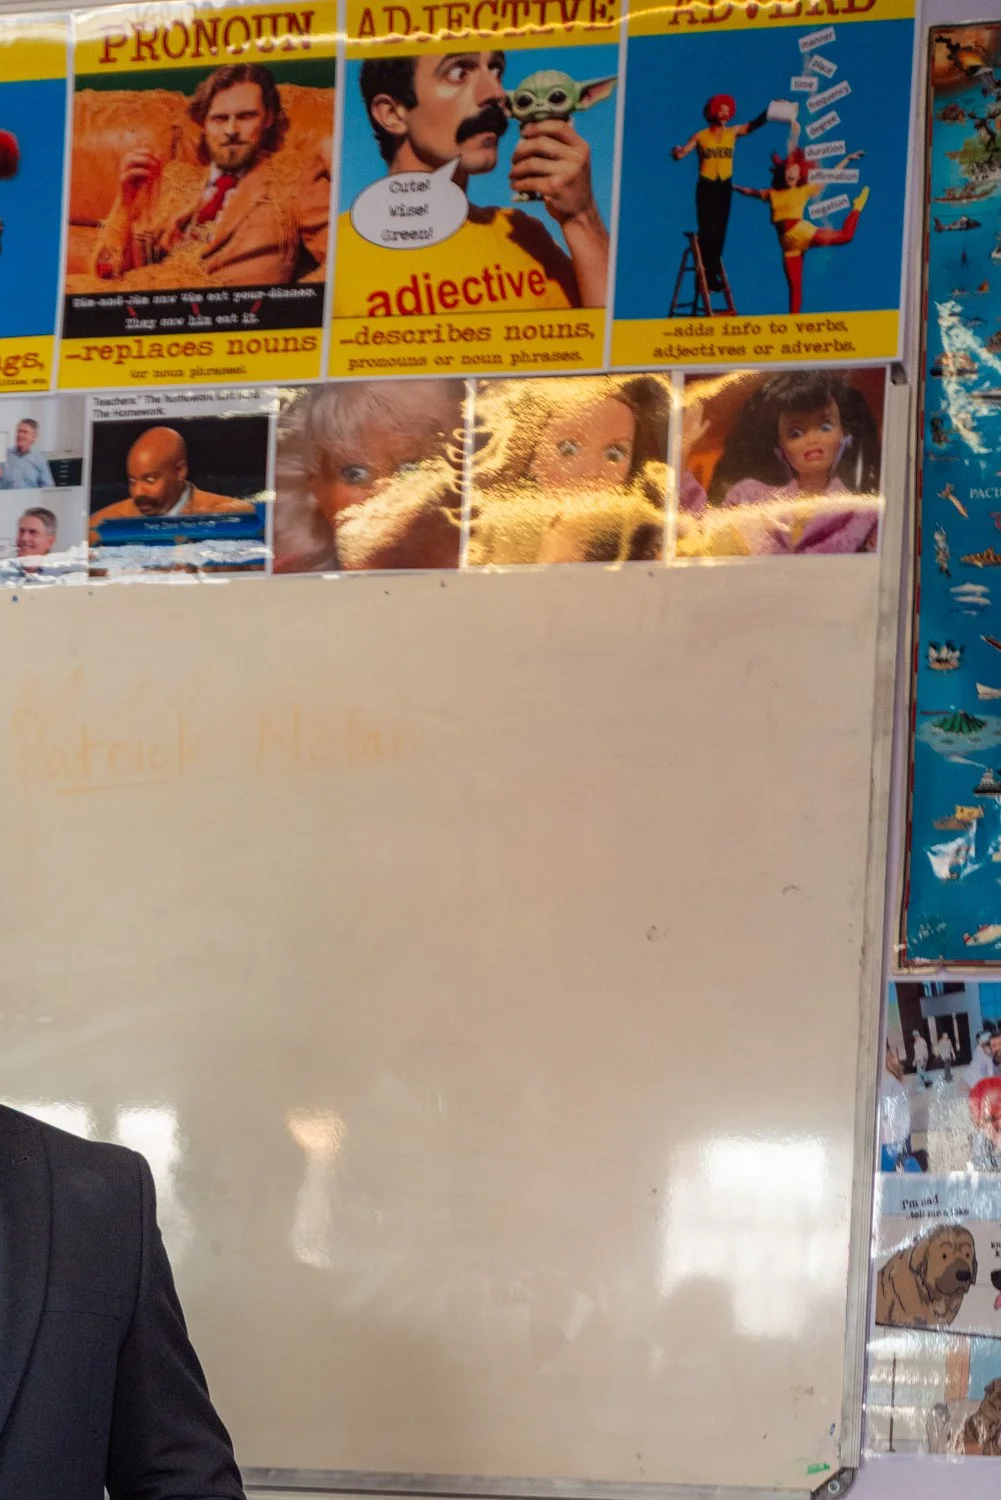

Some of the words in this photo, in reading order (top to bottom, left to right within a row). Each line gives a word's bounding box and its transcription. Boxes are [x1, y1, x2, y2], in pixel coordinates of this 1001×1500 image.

[357, 0, 616, 45] ADJECTIVE
[98, 9, 316, 64] PRONOUN
[388, 179, 432, 194] Cute!
[388, 203, 430, 217] Wise!
[380, 227, 434, 242] Green!
[366, 264, 547, 318] adjective
[720, 322, 762, 337] info
[768, 321, 788, 334] to
[226, 335, 317, 357] nouns
[651, 343, 748, 360] adjectives
[753, 342, 775, 356] or
[347, 355, 428, 372] pronouns
[433, 354, 454, 366] or
[460, 353, 503, 366] noun
